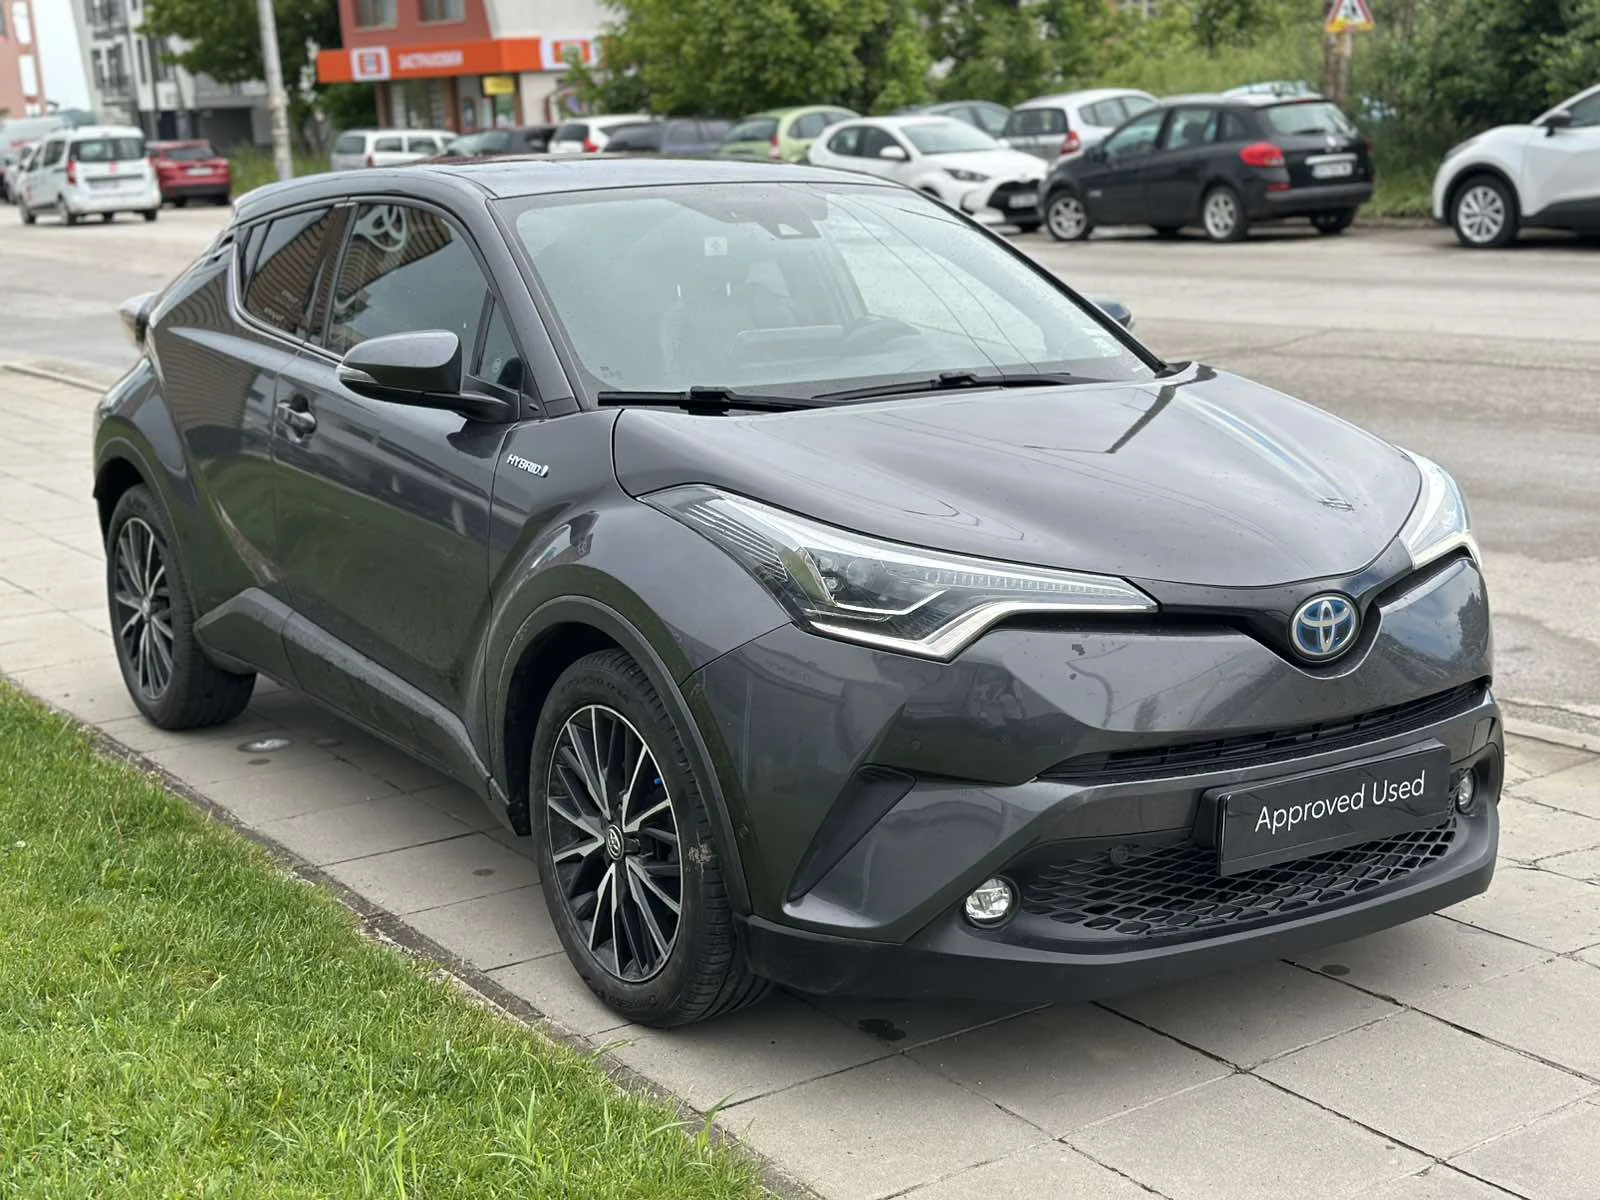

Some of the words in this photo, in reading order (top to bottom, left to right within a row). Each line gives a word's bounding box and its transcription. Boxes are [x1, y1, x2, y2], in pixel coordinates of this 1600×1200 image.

[507, 454, 541, 475] HYBRID
[1255, 784, 1366, 834] Approved
[1372, 769, 1426, 806] Used
